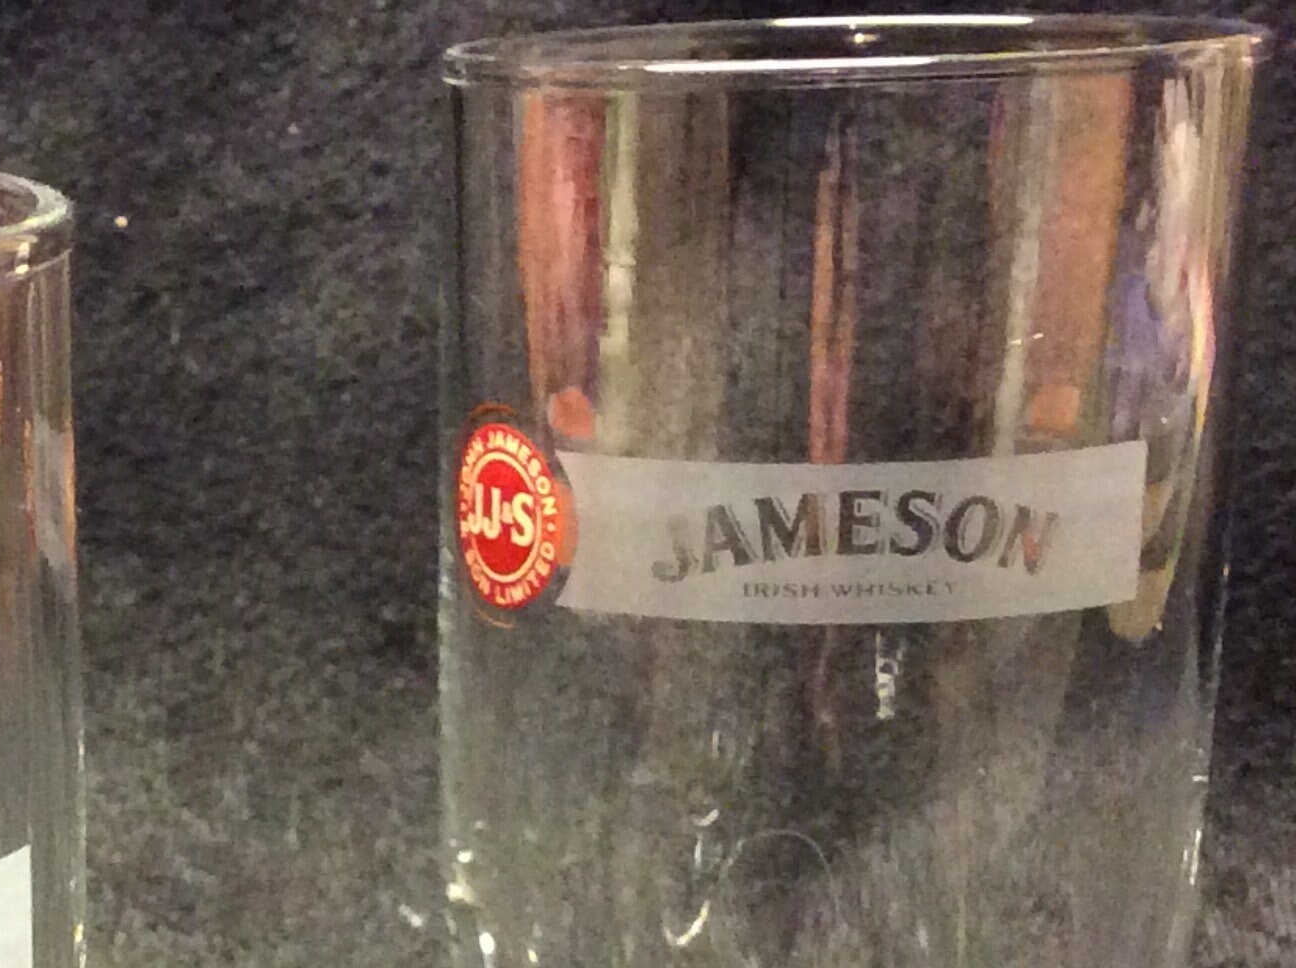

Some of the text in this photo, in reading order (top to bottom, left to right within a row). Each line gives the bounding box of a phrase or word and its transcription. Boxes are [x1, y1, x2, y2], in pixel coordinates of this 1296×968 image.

[487, 430, 557, 515] JAMESON
[651, 489, 1059, 582] JAMESON
[742, 579, 957, 598] IRISH WHISKEY
